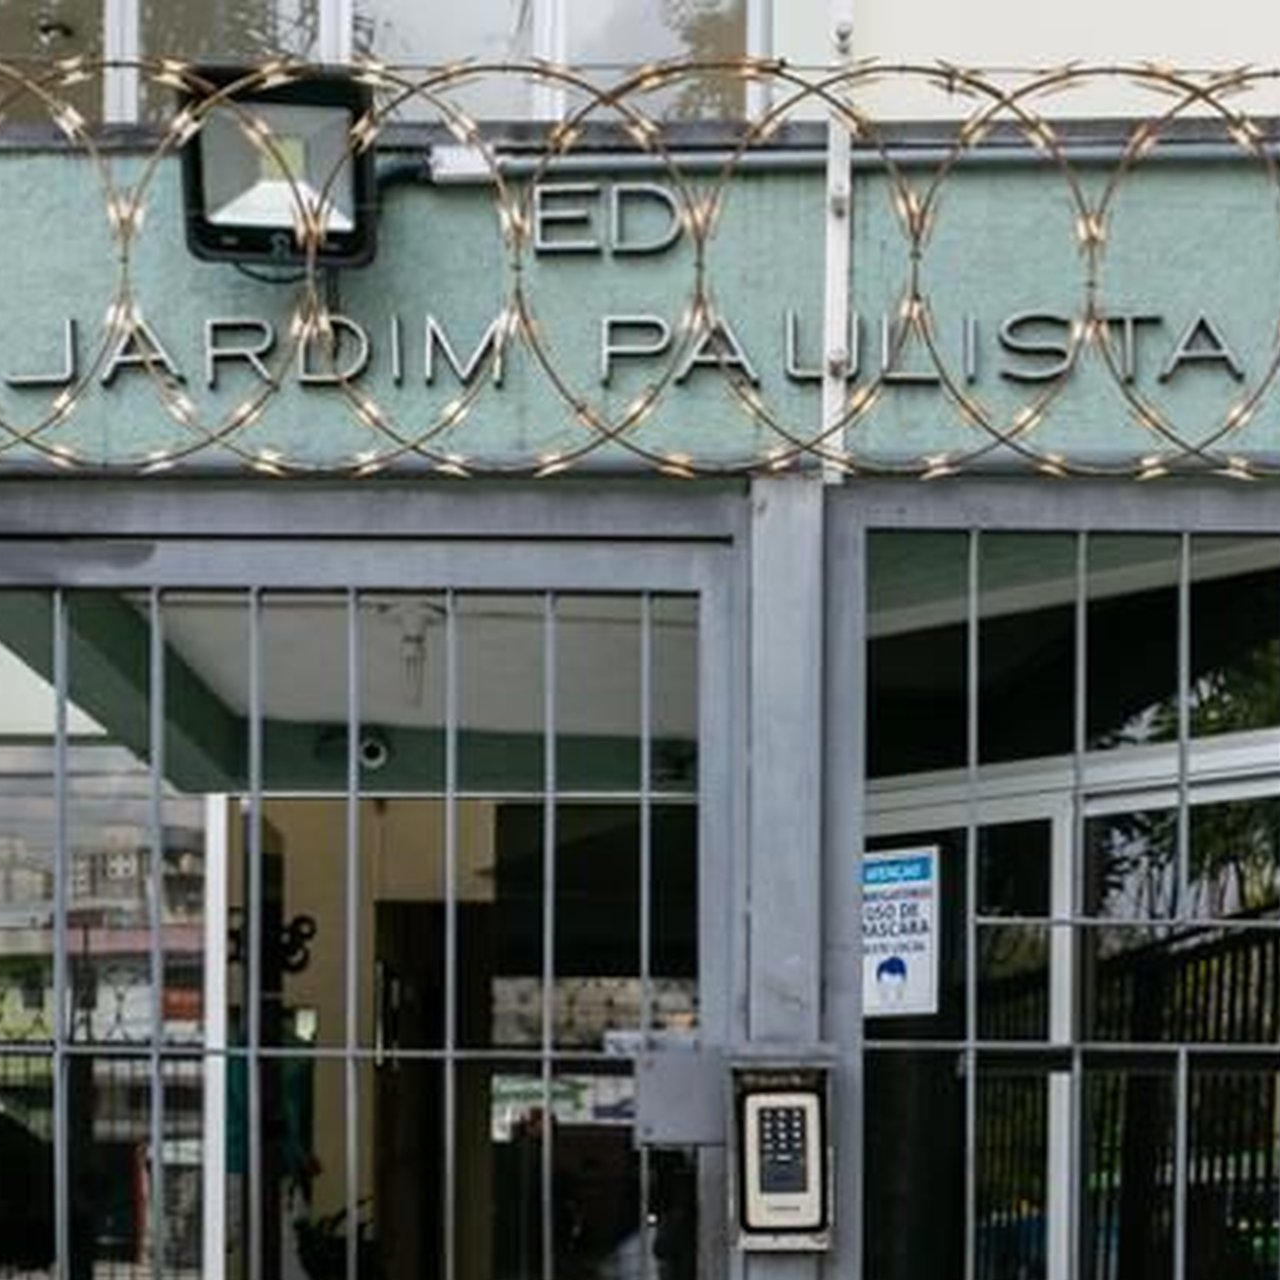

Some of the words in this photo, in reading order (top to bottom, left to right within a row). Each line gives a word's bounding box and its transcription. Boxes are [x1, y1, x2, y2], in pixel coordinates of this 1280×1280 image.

[533, 183, 685, 254] ED
[3, 314, 508, 388] JARDIM
[599, 312, 1246, 386] PAULISTA
[900, 902, 919, 918] DE
